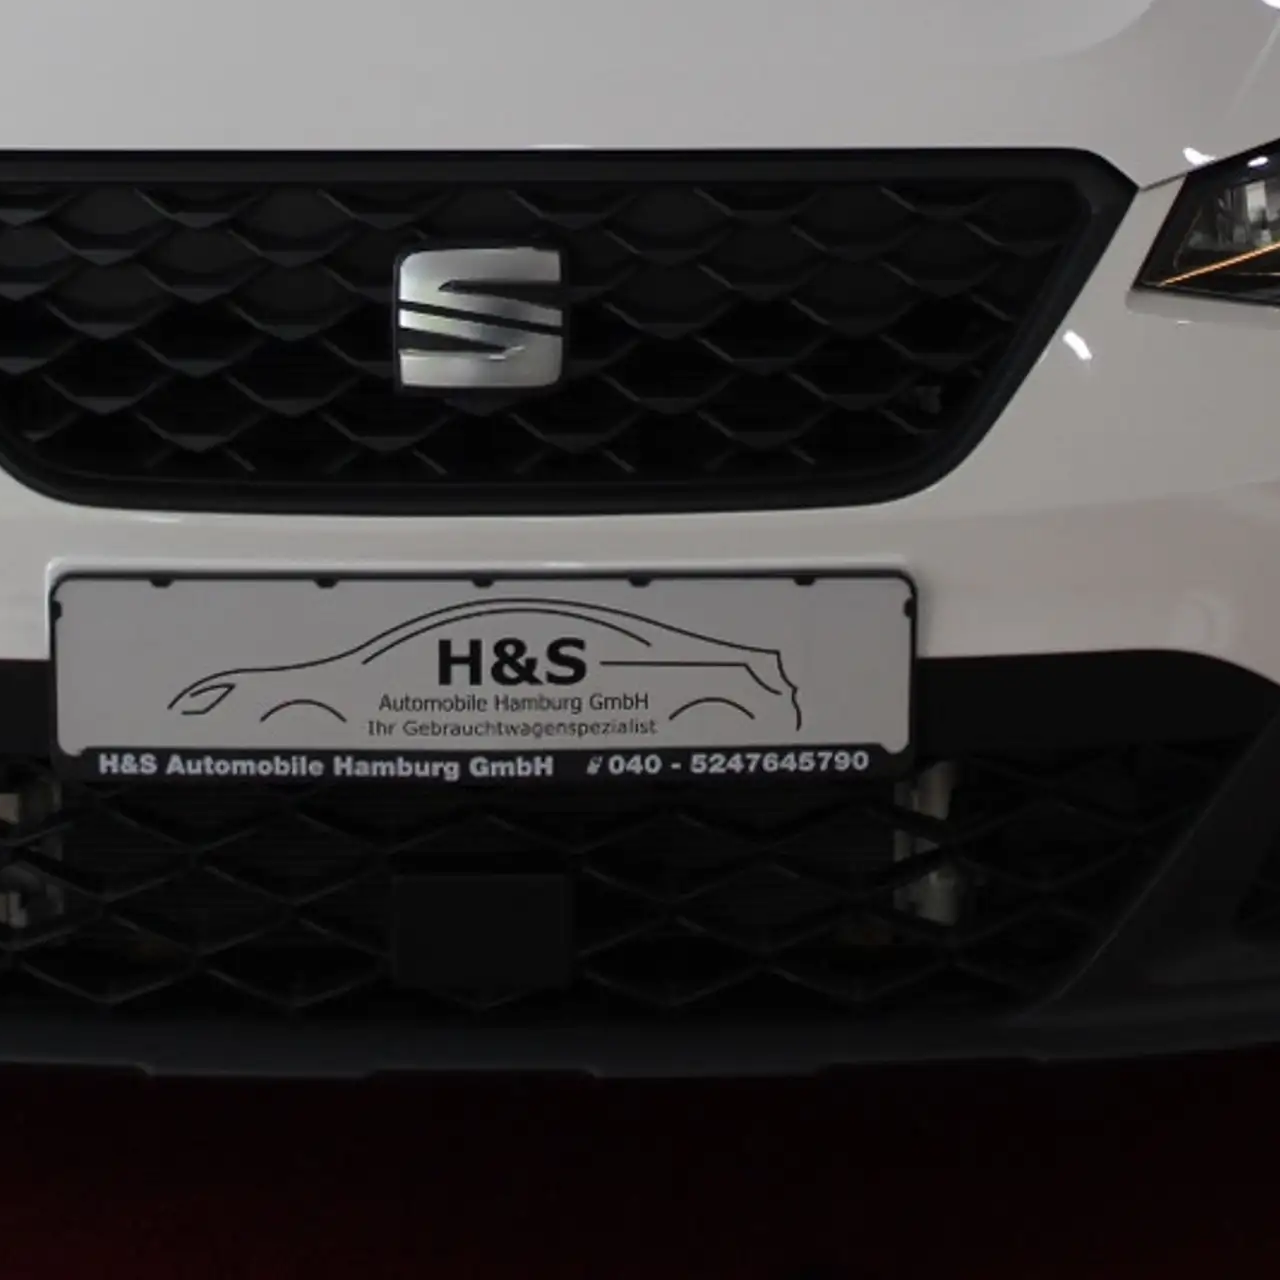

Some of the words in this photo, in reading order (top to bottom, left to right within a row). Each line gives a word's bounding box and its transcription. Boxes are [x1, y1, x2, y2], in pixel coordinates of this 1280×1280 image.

[438, 637, 587, 686] H&S
[379, 694, 487, 712] Automobile
[495, 694, 582, 714] Hamburg
[589, 693, 649, 711] GmbH
[368, 720, 395, 737] Ihr
[403, 718, 658, 739] Gebrauchtwagenspezialist
[98, 754, 158, 775] H&S
[166, 756, 324, 777] Automobile
[334, 756, 461, 781] Hamburg
[470, 756, 553, 776] GmbH
[608, 754, 662, 774] 040
[690, 752, 869, 774] 5247645790
